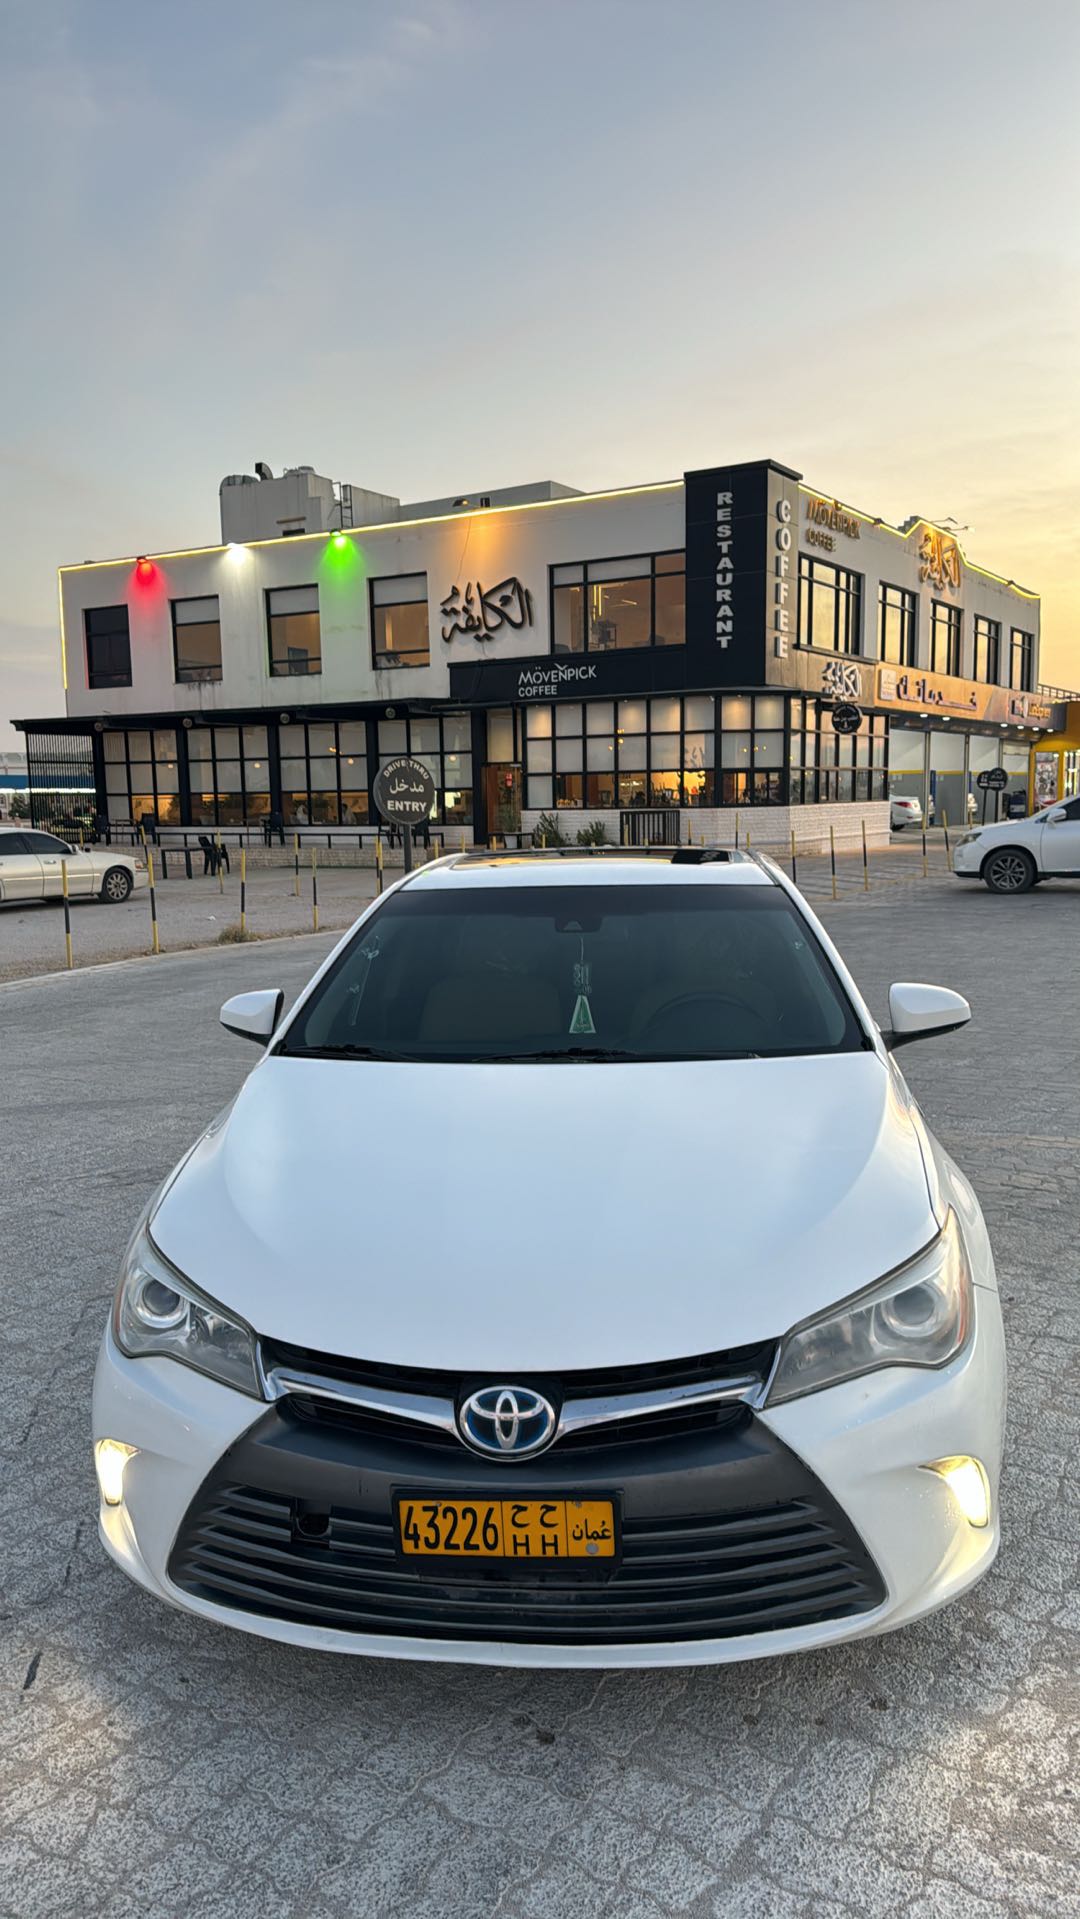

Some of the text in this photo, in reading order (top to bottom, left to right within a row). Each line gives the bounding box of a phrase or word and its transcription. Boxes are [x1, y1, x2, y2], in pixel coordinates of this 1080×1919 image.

[805, 528, 837, 552] COFFEE
[716, 491, 734, 648] RESTAURANT
[775, 500, 791, 658] COFFEE
[518, 663, 597, 685] MÖVENPICK
[518, 684, 558, 697] COFFEE
[383, 759, 430, 780] DRIVE THRU
[389, 777, 425, 794] مدخل
[387, 800, 427, 813] ENTRY
[404, 1506, 499, 1551] 43226
